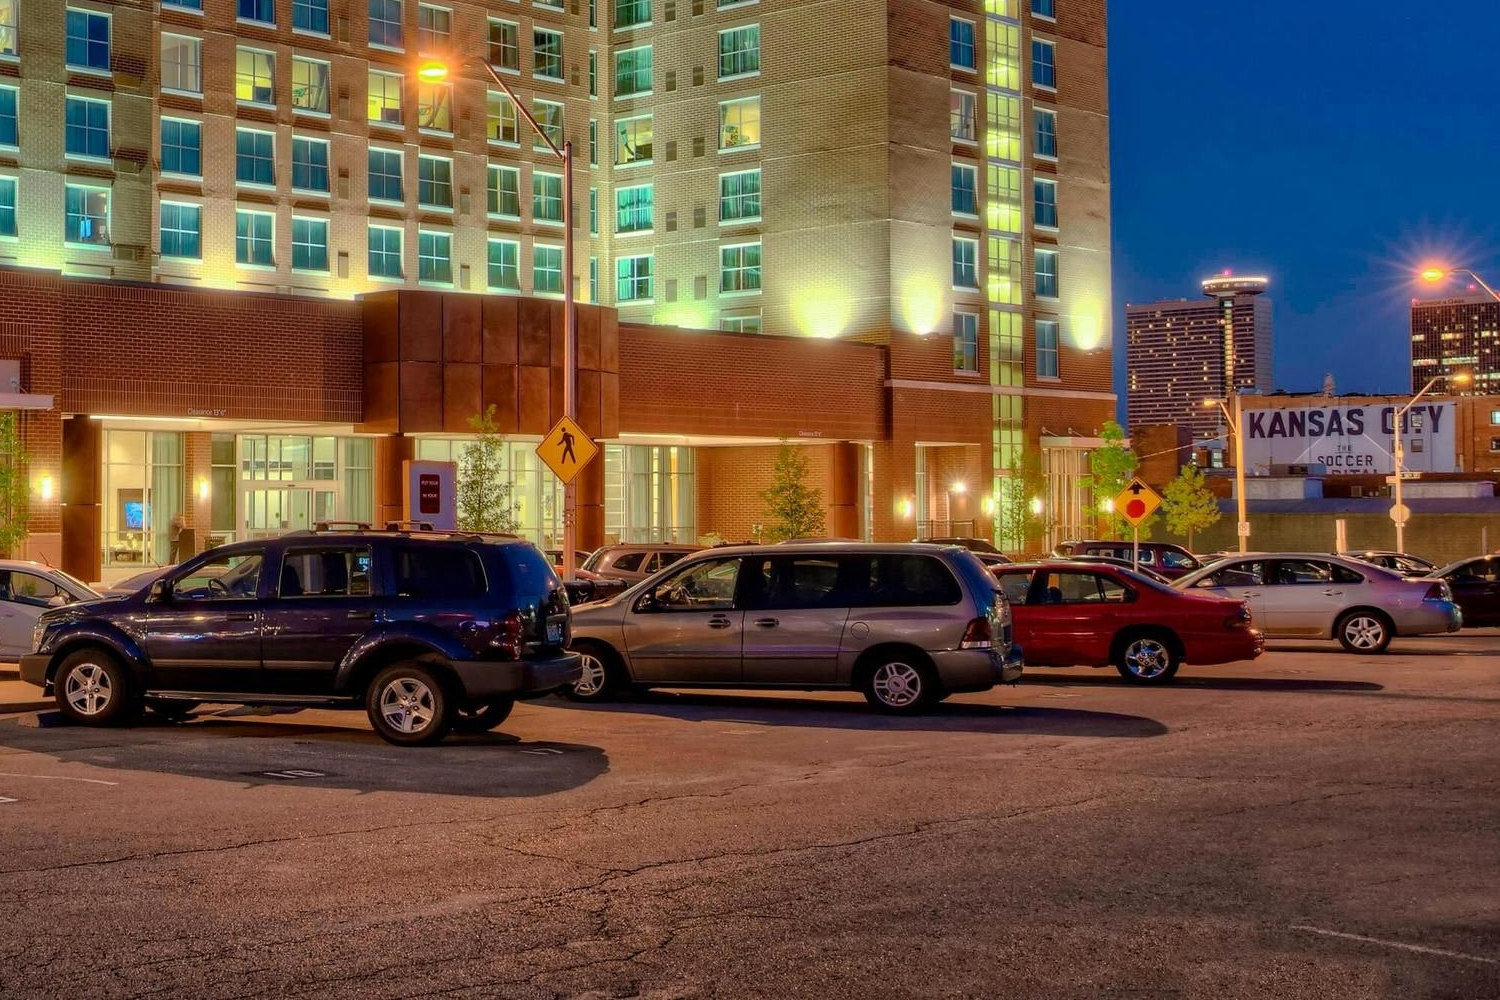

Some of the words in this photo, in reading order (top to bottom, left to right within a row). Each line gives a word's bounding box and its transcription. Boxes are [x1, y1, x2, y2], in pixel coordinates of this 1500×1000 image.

[1249, 408, 1364, 439] KANSAS
[1381, 405, 1444, 435] CITY
[1337, 444, 1352, 452] THE
[1317, 455, 1373, 467] SOCCER
